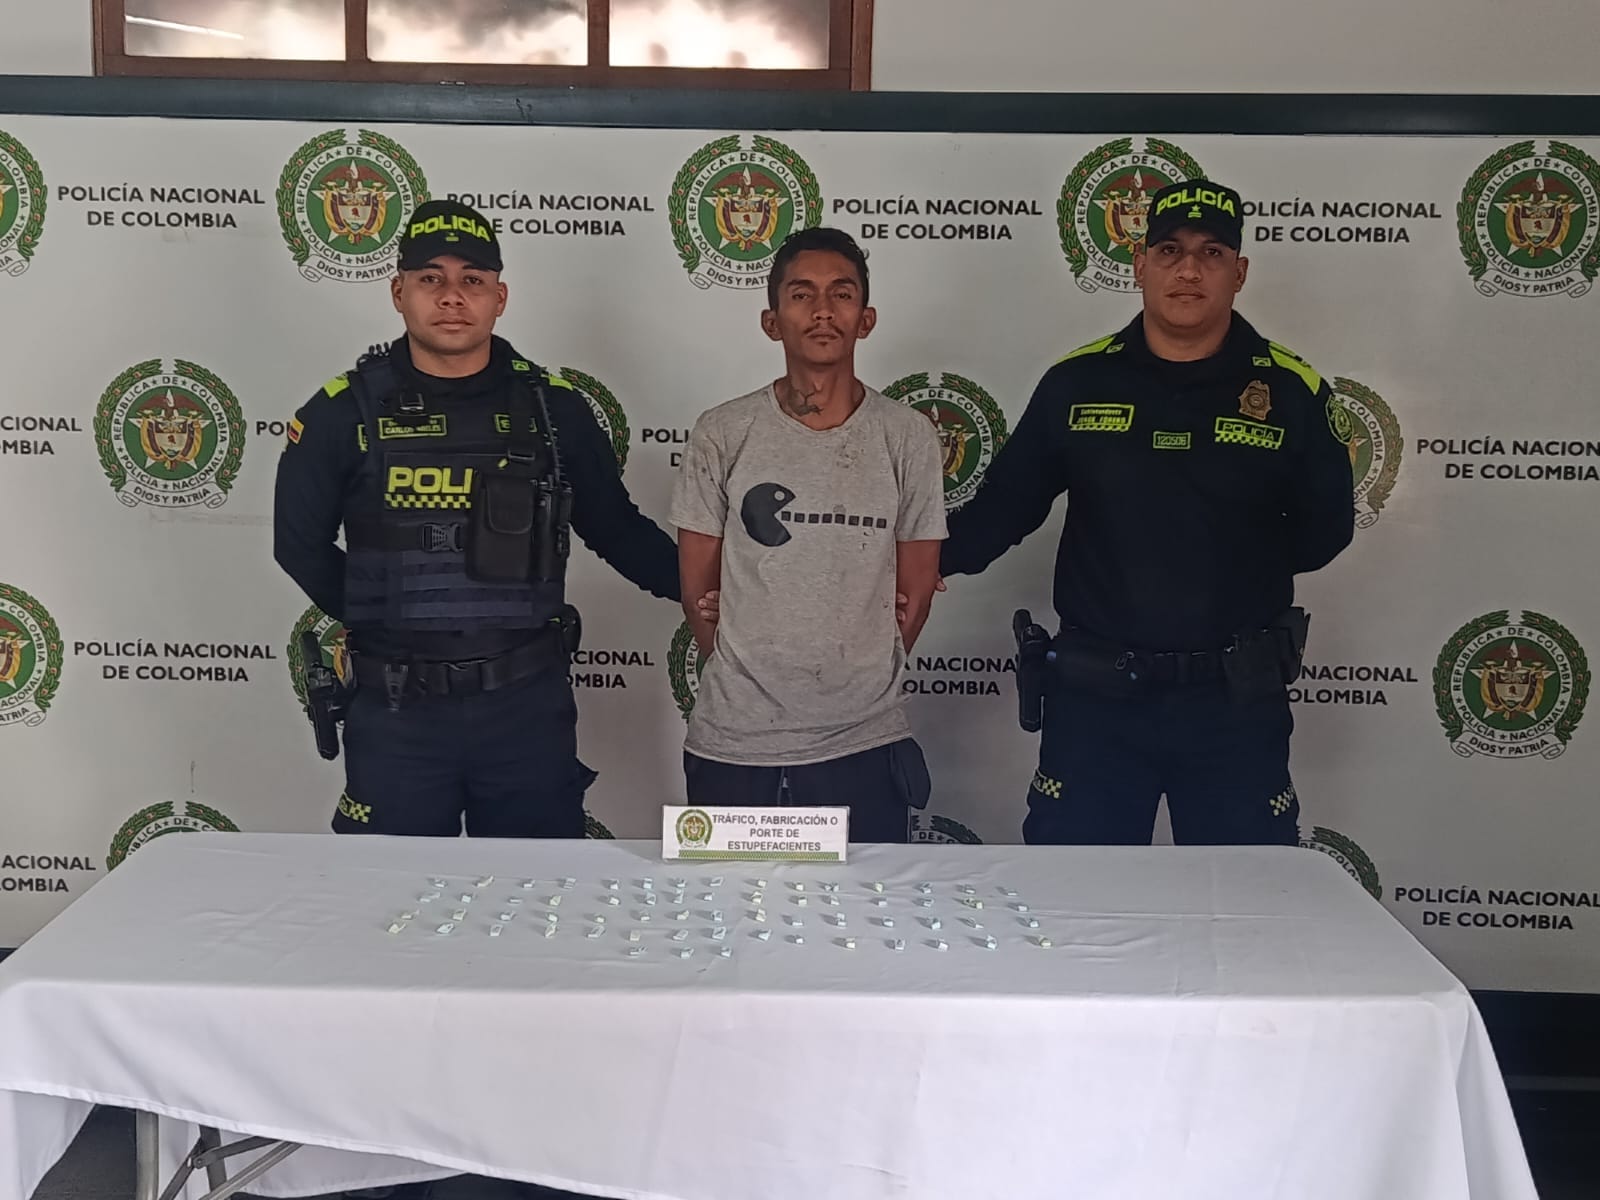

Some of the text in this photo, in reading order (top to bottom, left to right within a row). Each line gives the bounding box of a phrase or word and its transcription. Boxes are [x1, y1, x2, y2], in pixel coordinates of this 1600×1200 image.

[1132, 155, 1148, 164] DE
[0, 153, 28, 208] OLOMBIA
[346, 147, 362, 155] DE
[376, 154, 412, 215] COLOMBIA
[740, 153, 756, 161] DE
[769, 161, 803, 221] COLOMBIA
[58, 183, 266, 204] POLICÍA NACIONAL
[1534, 158, 1551, 167] DE
[1563, 166, 1597, 228] COLOMBIA
[539, 194, 655, 212] NACIONAL
[833, 195, 1043, 216] POLICÍA NACIONAL
[1155, 188, 1235, 218] POLICÍA
[1243, 198, 1442, 219] OLICÍA NACIONAL
[87, 211, 237, 229] DE COLOMBIA
[493, 219, 626, 236] E COLOMBIA
[0, 223, 25, 248] ONAL
[861, 223, 1012, 241] DE COLOMBIA
[1255, 226, 1410, 243] DE COLOMBIA
[1534, 239, 1593, 279] NACIONAL
[356, 263, 395, 279] PATRIA
[745, 276, 769, 286] PAT
[1533, 277, 1575, 293] PATRIA
[162, 376, 179, 385] DE
[191, 383, 228, 443] COLOMBIA
[0, 416, 83, 432] CIONAL
[928, 390, 991, 456] DE COLOMBIA
[1350, 401, 1383, 461] COLOMBIA
[642, 428, 689, 444] POLI
[0, 440, 55, 455] MBIA
[1417, 436, 1600, 457] POLICÍA NACION
[173, 455, 223, 490] NACIONAL
[388, 466, 473, 494] POLI
[1445, 463, 1600, 481] DE COLOMBIA
[173, 488, 211, 504] PATRIA
[9, 605, 45, 663] COLOMBIA
[74, 638, 277, 660] POLICÍA NACIONAL
[571, 651, 655, 666] CIONAL
[917, 657, 1018, 673] NACIONA
[1508, 627, 1525, 636] DE
[1537, 634, 1570, 694] COLOMBIA
[102, 665, 249, 682] DE COLOMBIA
[1301, 665, 1418, 683] NACIONAL
[0, 675, 41, 707] ACIONAL
[902, 679, 1001, 696] OLOMBIA
[1287, 688, 1388, 705] OLOMBIA
[0, 707, 30, 722] ATRIA
[1510, 707, 1566, 741] NACIONAL
[1508, 738, 1549, 754] PATRIA
[174, 818, 190, 826] DE
[712, 813, 838, 826] TRÁFICO, FABRICACIÓN O
[750, 828, 799, 838] PORTE DE
[728, 841, 821, 851] ESTUPEFACIENTES
[1, 855, 97, 871] ACIONAL
[0, 877, 69, 893] OMBIA
[1395, 885, 1600, 908] POLICÍA NACIONAL
[1422, 911, 1574, 930] DE COLOMBIA
